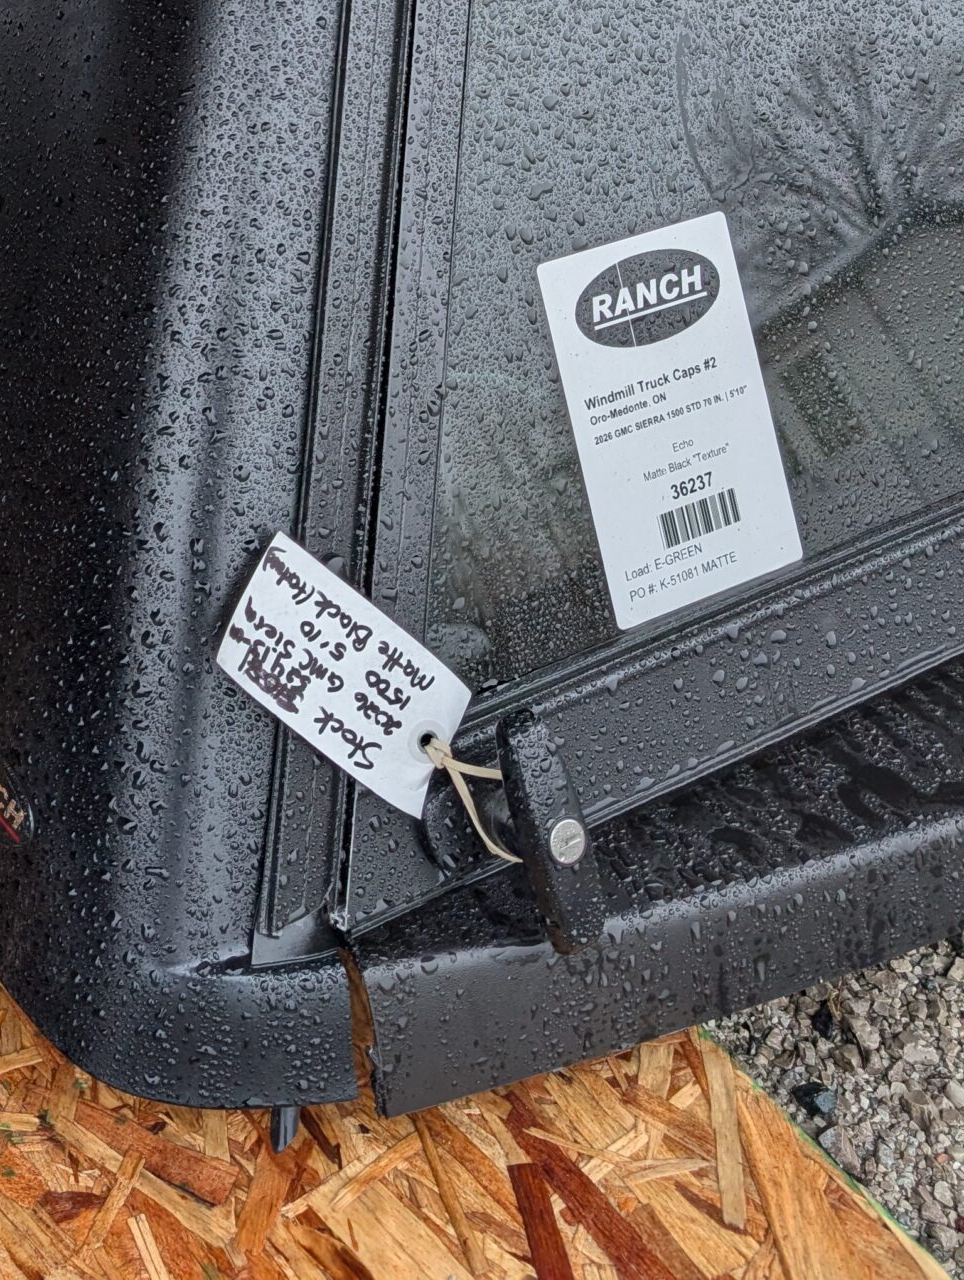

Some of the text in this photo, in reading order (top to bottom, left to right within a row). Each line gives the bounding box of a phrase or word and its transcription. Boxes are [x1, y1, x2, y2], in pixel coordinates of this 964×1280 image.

[593, 265, 702, 322] RANCH
[584, 357, 717, 410] Windmill Truck Caps #2
[652, 392, 666, 404] ON
[594, 432, 613, 445] 2026
[614, 425, 633, 438] GMC
[635, 414, 665, 431] SIERRA
[667, 407, 684, 419] 1500
[686, 401, 701, 413] STD
[703, 397, 712, 407] 70
[713, 393, 725, 404] IN.
[643, 443, 729, 481] Matte Black "Texture"
[672, 439, 694, 452] Echo
[670, 471, 712, 500] 36237
[625, 543, 702, 581] Load: E-GREEN
[629, 551, 737, 602] PO #: K-51081 MATTE
[312, 591, 373, 652] Black
[298, 649, 344, 693] GMC
[378, 641, 435, 691] Matte
[365, 670, 411, 711] 1500
[313, 706, 382, 770] Stock
